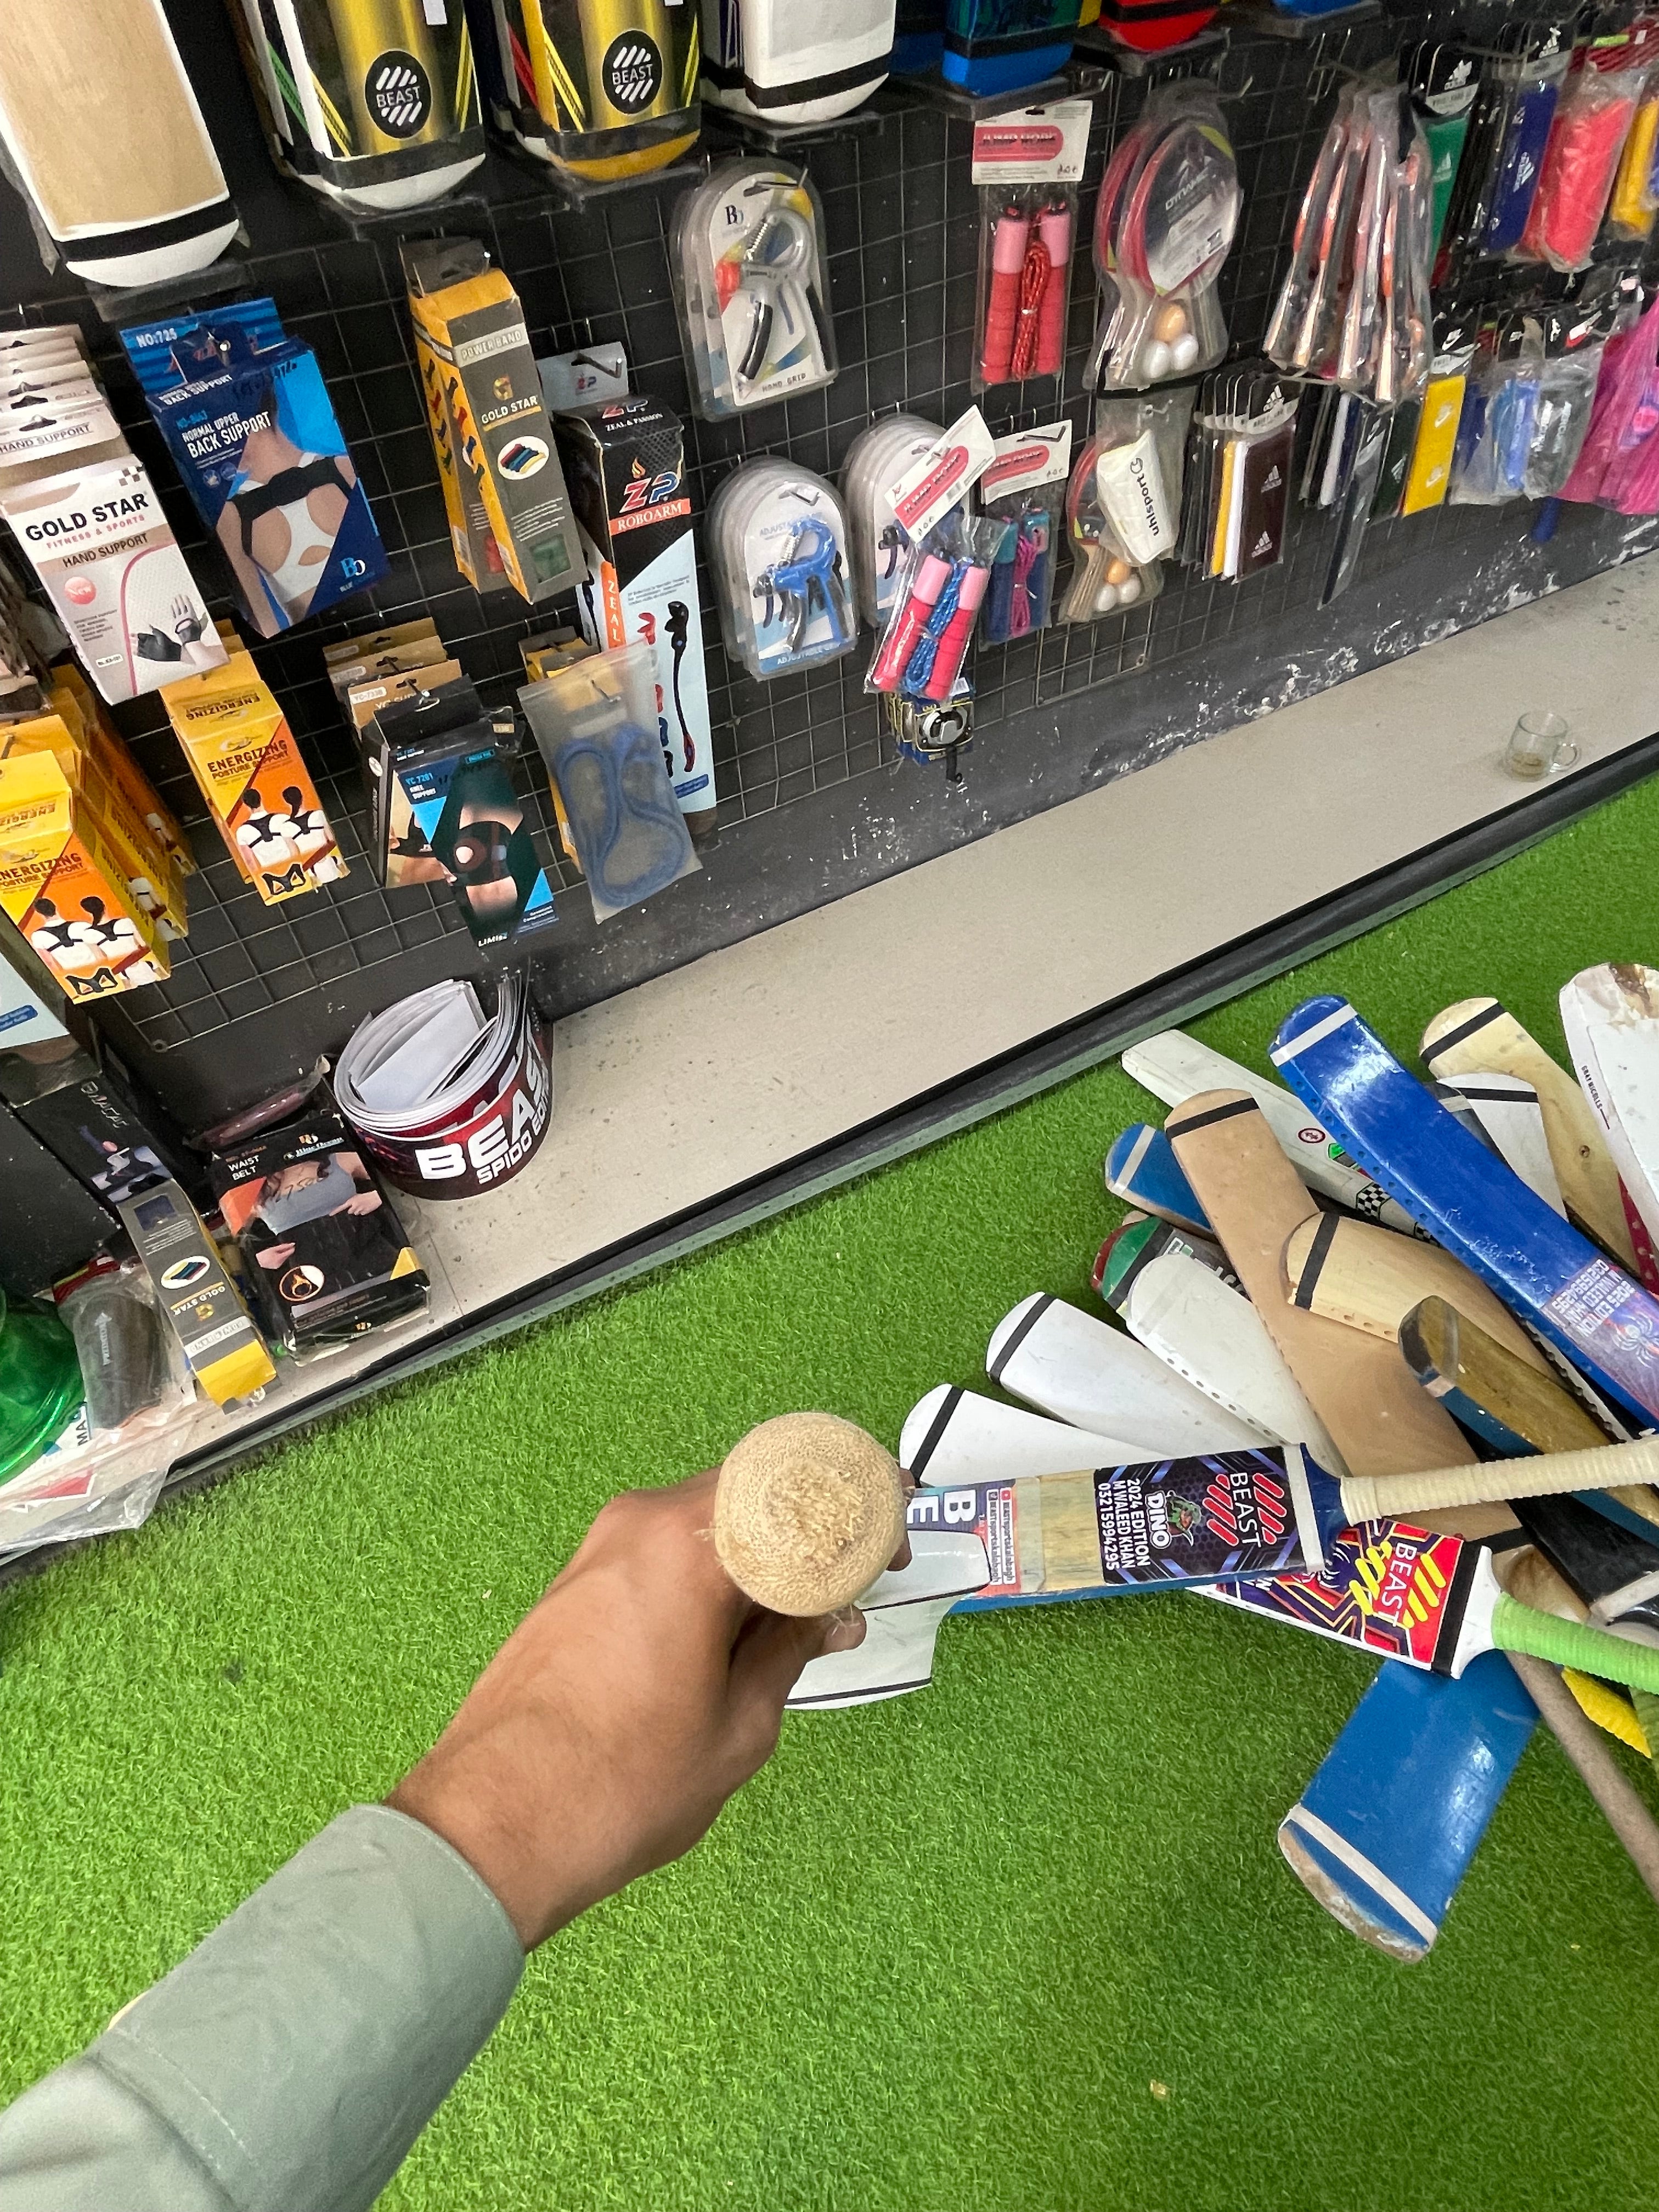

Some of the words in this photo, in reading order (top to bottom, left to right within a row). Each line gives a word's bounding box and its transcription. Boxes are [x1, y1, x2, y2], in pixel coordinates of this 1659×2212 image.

[612, 63, 653, 86] BEAST
[376, 86, 421, 109] BEAST
[461, 338, 494, 360] POWER
[496, 330, 522, 347] BAND
[482, 405, 509, 425] GOLD
[510, 396, 539, 412] STAR
[606, 419, 626, 431] ZEAL
[39, 423, 92, 446] SUPPORT
[182, 424, 215, 443] NORMAL
[215, 412, 240, 431] UPPER
[188, 437, 221, 459] BACK
[221, 411, 272, 446] SUPPORT
[26, 512, 87, 541] GOLD
[92, 493, 149, 522] STAR
[618, 502, 682, 532] ROBOARM
[1136, 472, 1160, 537] uhlsport
[47, 531, 92, 549] FITNESS
[95, 527, 103, 535] &
[106, 514, 145, 531] SPORTS
[62, 551, 97, 568] HAND
[99, 533, 149, 557] SUPPORT
[606, 580, 620, 642] ZEAL
[186, 694, 261, 720] ENERGIZING
[207, 740, 288, 773] ENERGIZING
[212, 761, 251, 780] POSTURE
[0, 852, 82, 881] NERGIZING
[228, 1155, 260, 1172] WAIST
[476, 1129, 532, 1185] SPIDO
[232, 1166, 258, 1181] BELT
[173, 1298, 199, 1316] STAR
[199, 1286, 225, 1301] GOLD
[1606, 1280, 1636, 1308] 2025
[1576, 1301, 1615, 1338] EDITION
[1113, 1480, 1126, 1488] M
[1127, 1478, 1143, 1508] 2024
[1113, 1488, 1131, 1536] WALEED
[1146, 1492, 1171, 1548] DINO
[1230, 1472, 1262, 1548] BEAST
[1098, 1482, 1120, 1571] 03215994295
[1130, 1509, 1151, 1567] EDITION
[1118, 1536, 1136, 1568] KHAN
[1376, 1542, 1418, 1628] BEAST
